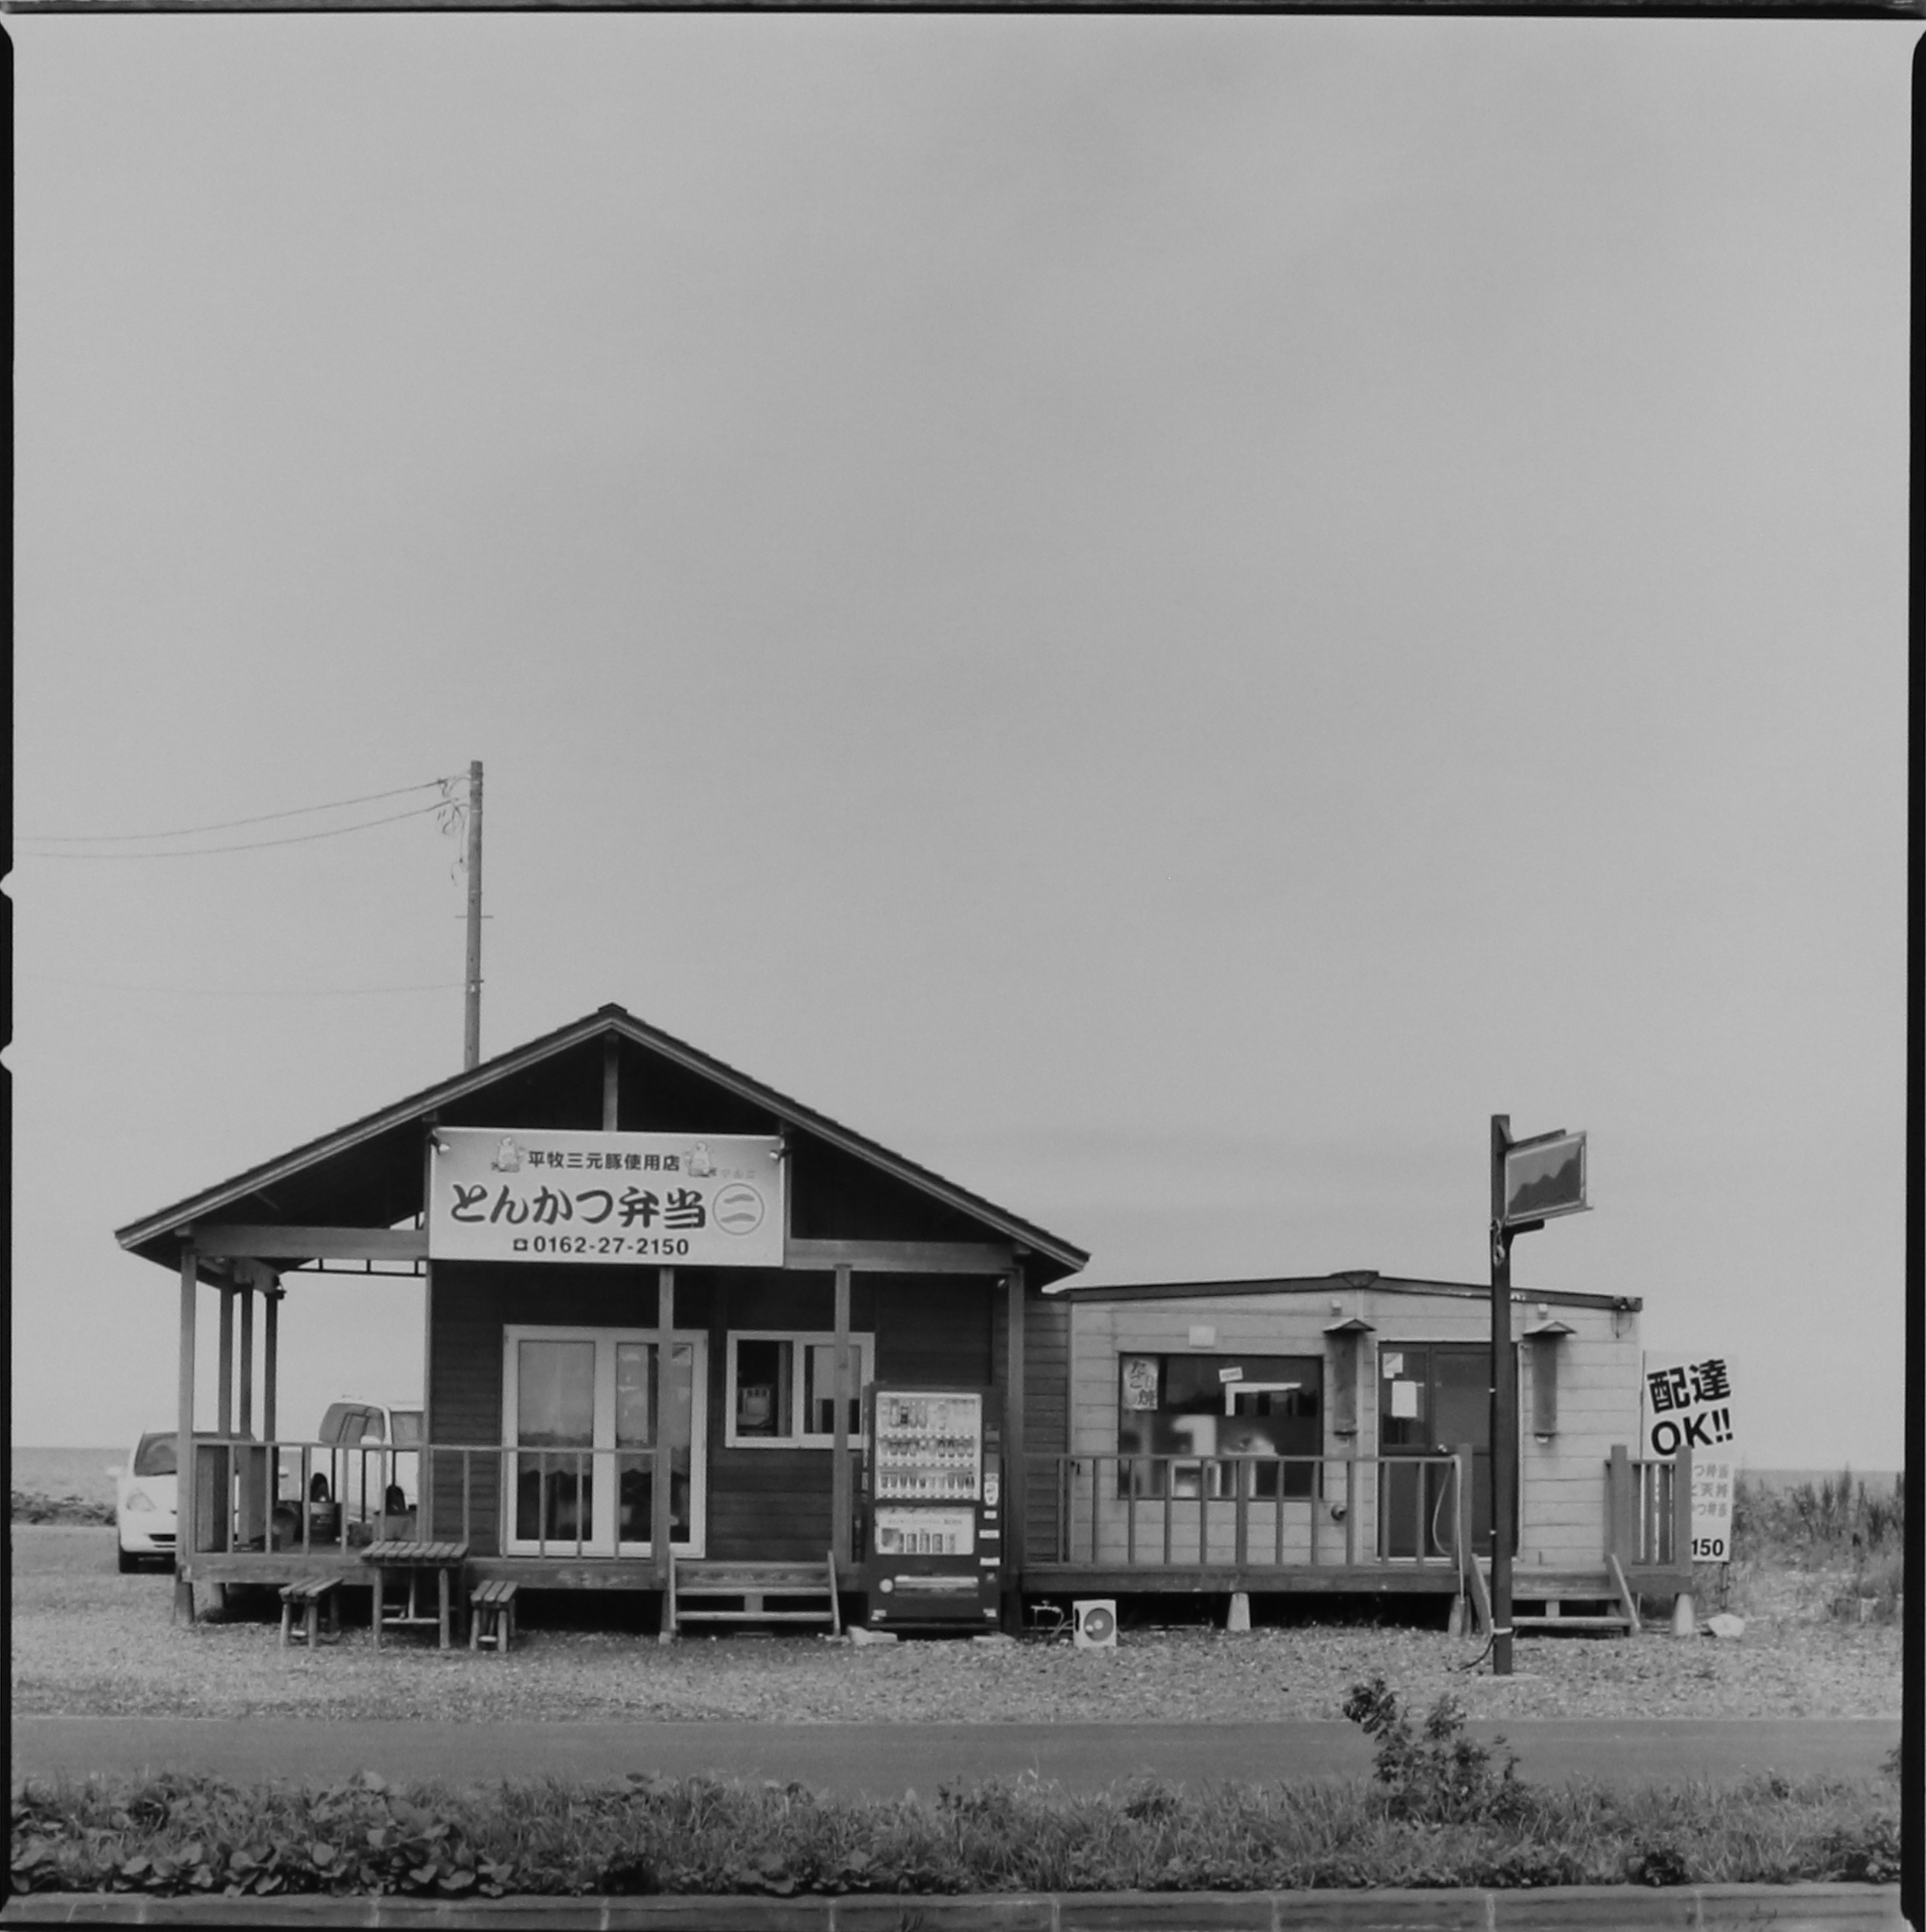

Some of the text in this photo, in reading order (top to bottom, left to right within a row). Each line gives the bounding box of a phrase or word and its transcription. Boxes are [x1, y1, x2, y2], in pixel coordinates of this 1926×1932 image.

[527, 1150, 680, 1172] 平牧三元豚使用店
[450, 1184, 707, 1229] とんかつ弁当
[533, 1235, 689, 1256] 0162-27-2150
[1646, 1358, 1731, 1414] 配達
[1651, 1408, 1733, 1457] OK!!
[1692, 1539, 1725, 1557] 150
